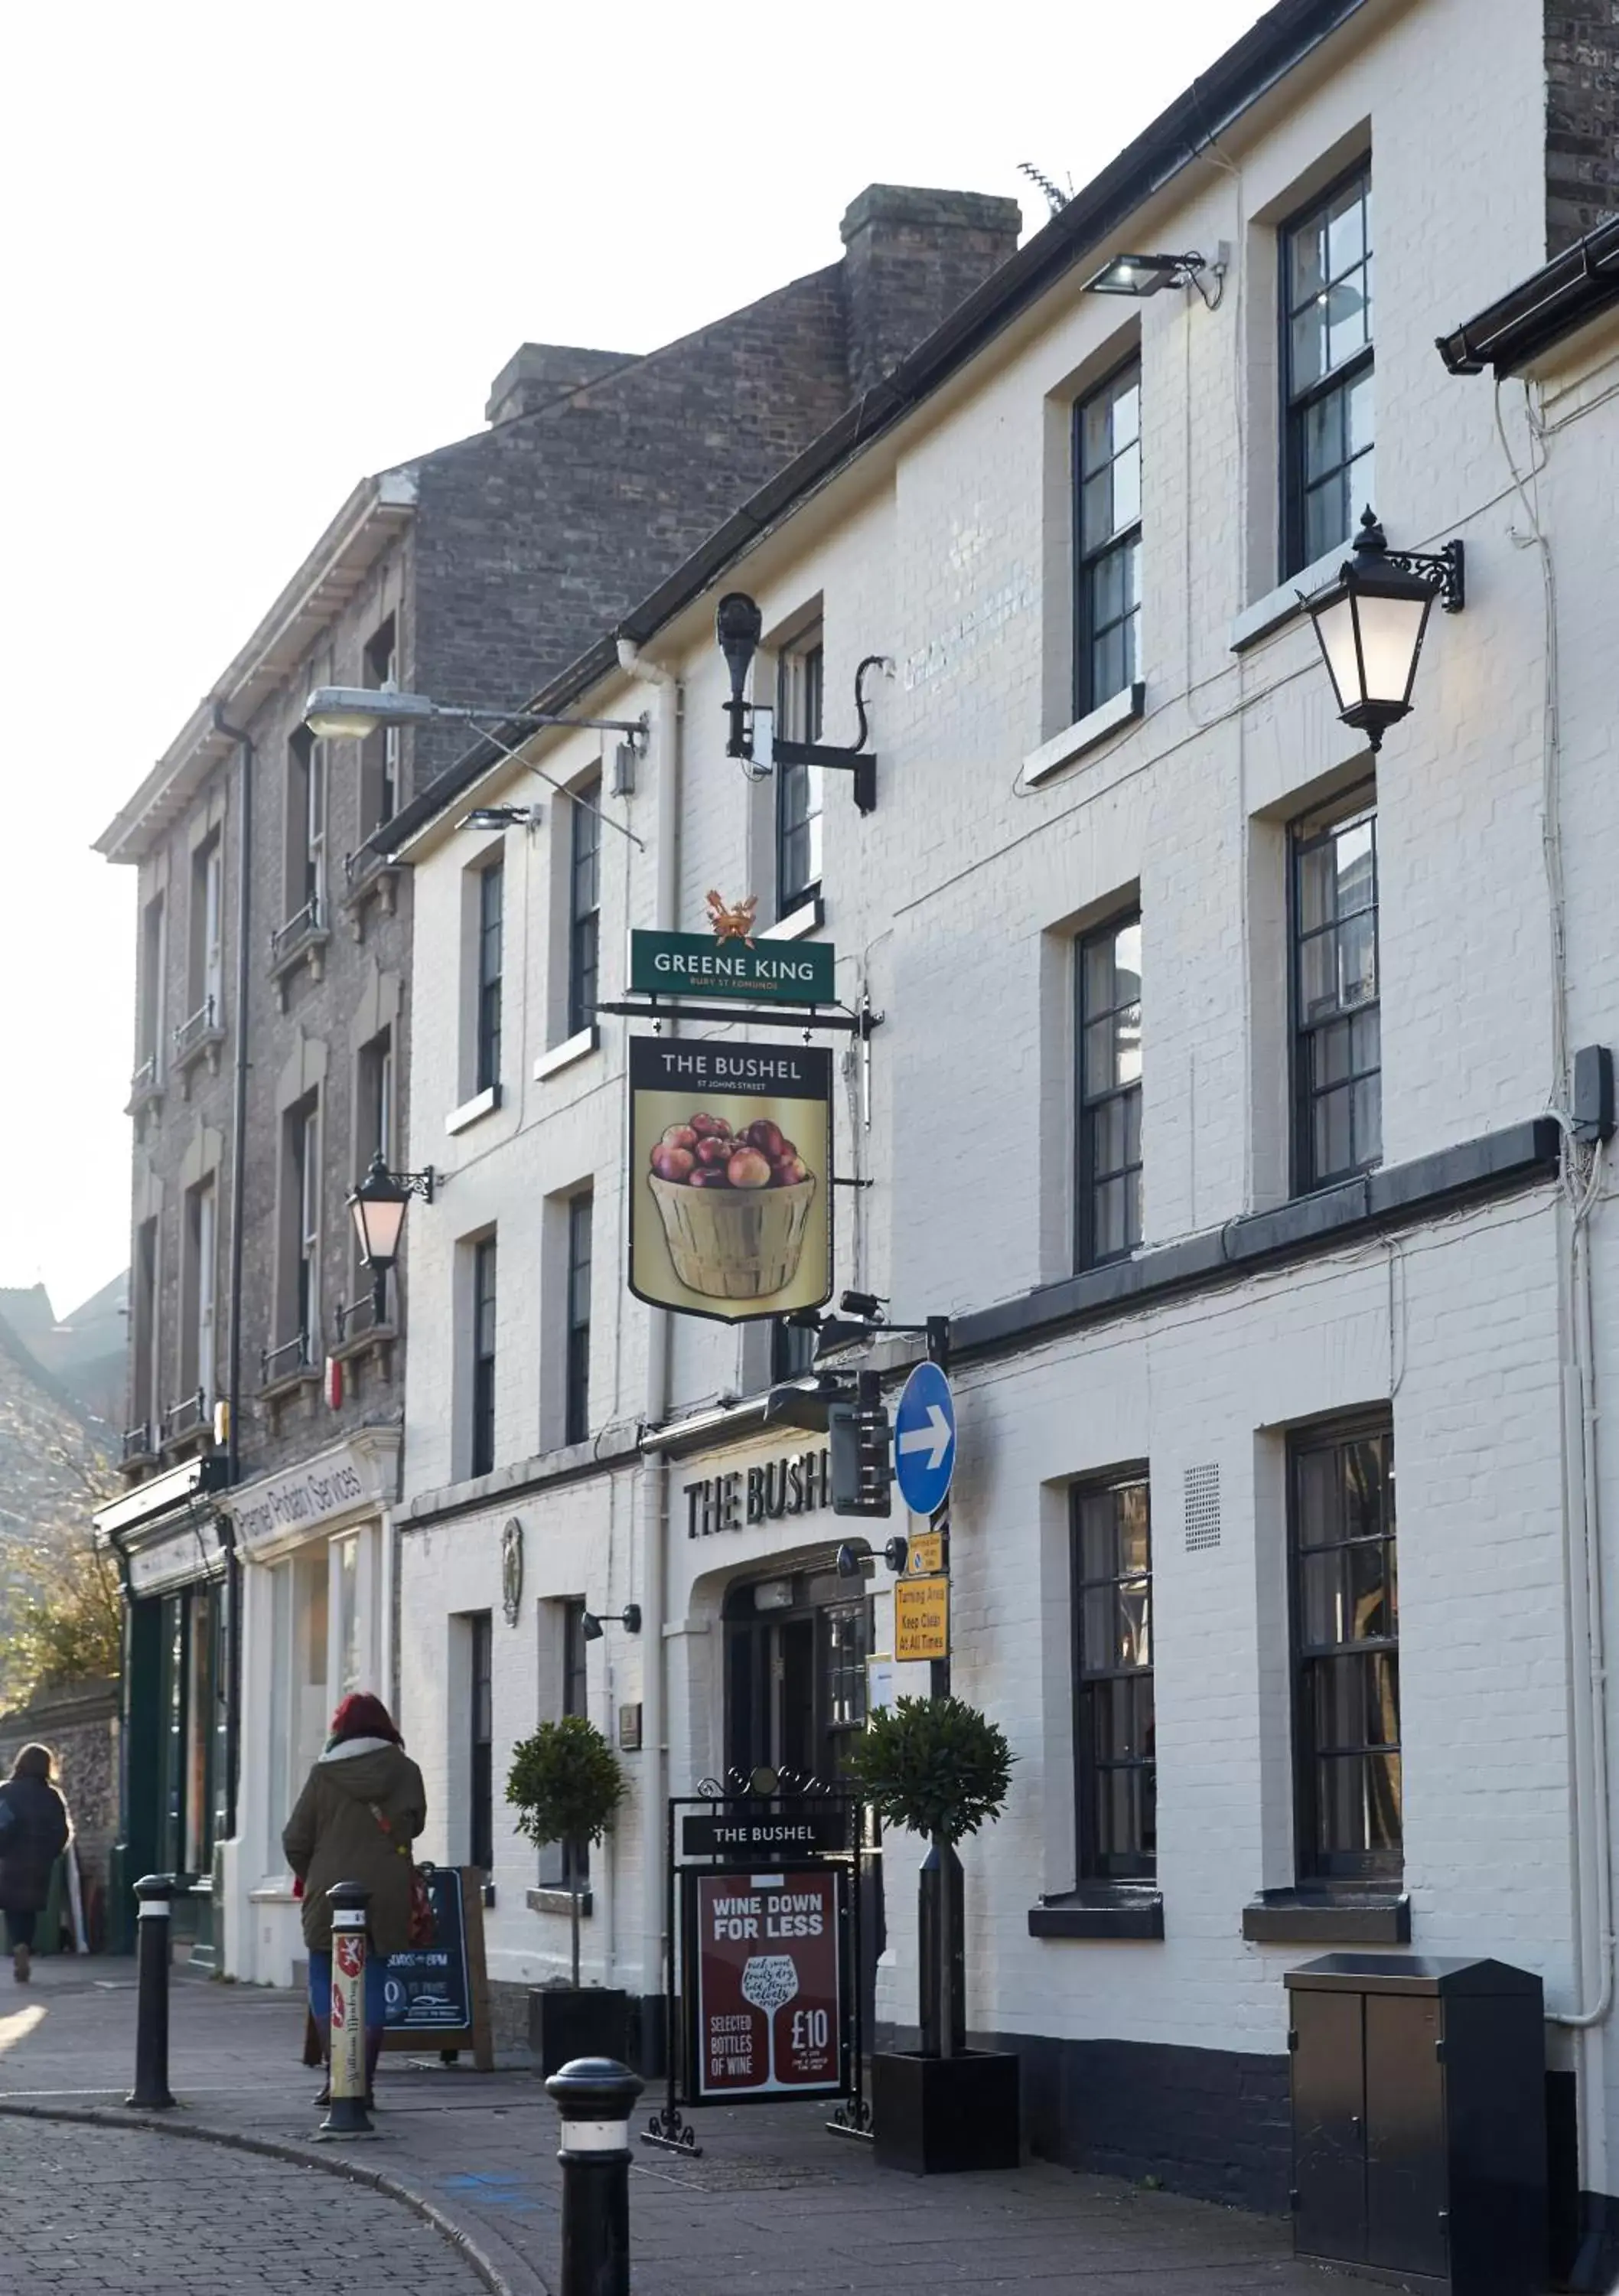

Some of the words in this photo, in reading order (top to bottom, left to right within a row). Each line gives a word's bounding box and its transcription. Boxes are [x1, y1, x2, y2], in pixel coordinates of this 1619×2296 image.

[654, 953, 746, 977] GREENE
[755, 960, 814, 981] KING
[661, 1054, 708, 1074] THE
[715, 1057, 802, 1079] BUSHEL
[697, 1079, 707, 1088] ST
[308, 1466, 362, 1512] Services
[683, 1471, 743, 1539] THE
[747, 1447, 834, 1525] BUSH
[902, 1615, 919, 1630] Keep
[910, 1635, 920, 1651] All
[922, 1634, 943, 1649] Times
[713, 1828, 748, 1843] THE
[752, 1826, 816, 1841] BUSHEL
[712, 1896, 762, 1916] WINE
[767, 1893, 823, 1913] DOWN
[714, 1917, 759, 1941] FOR
[767, 1914, 824, 1938] LESS
[711, 2014, 751, 2033] SELECTED
[791, 2009, 828, 2050] £10
[711, 2034, 752, 2055] BOTTLES
[711, 2058, 725, 2076] OF
[727, 2055, 753, 2076] WINE
